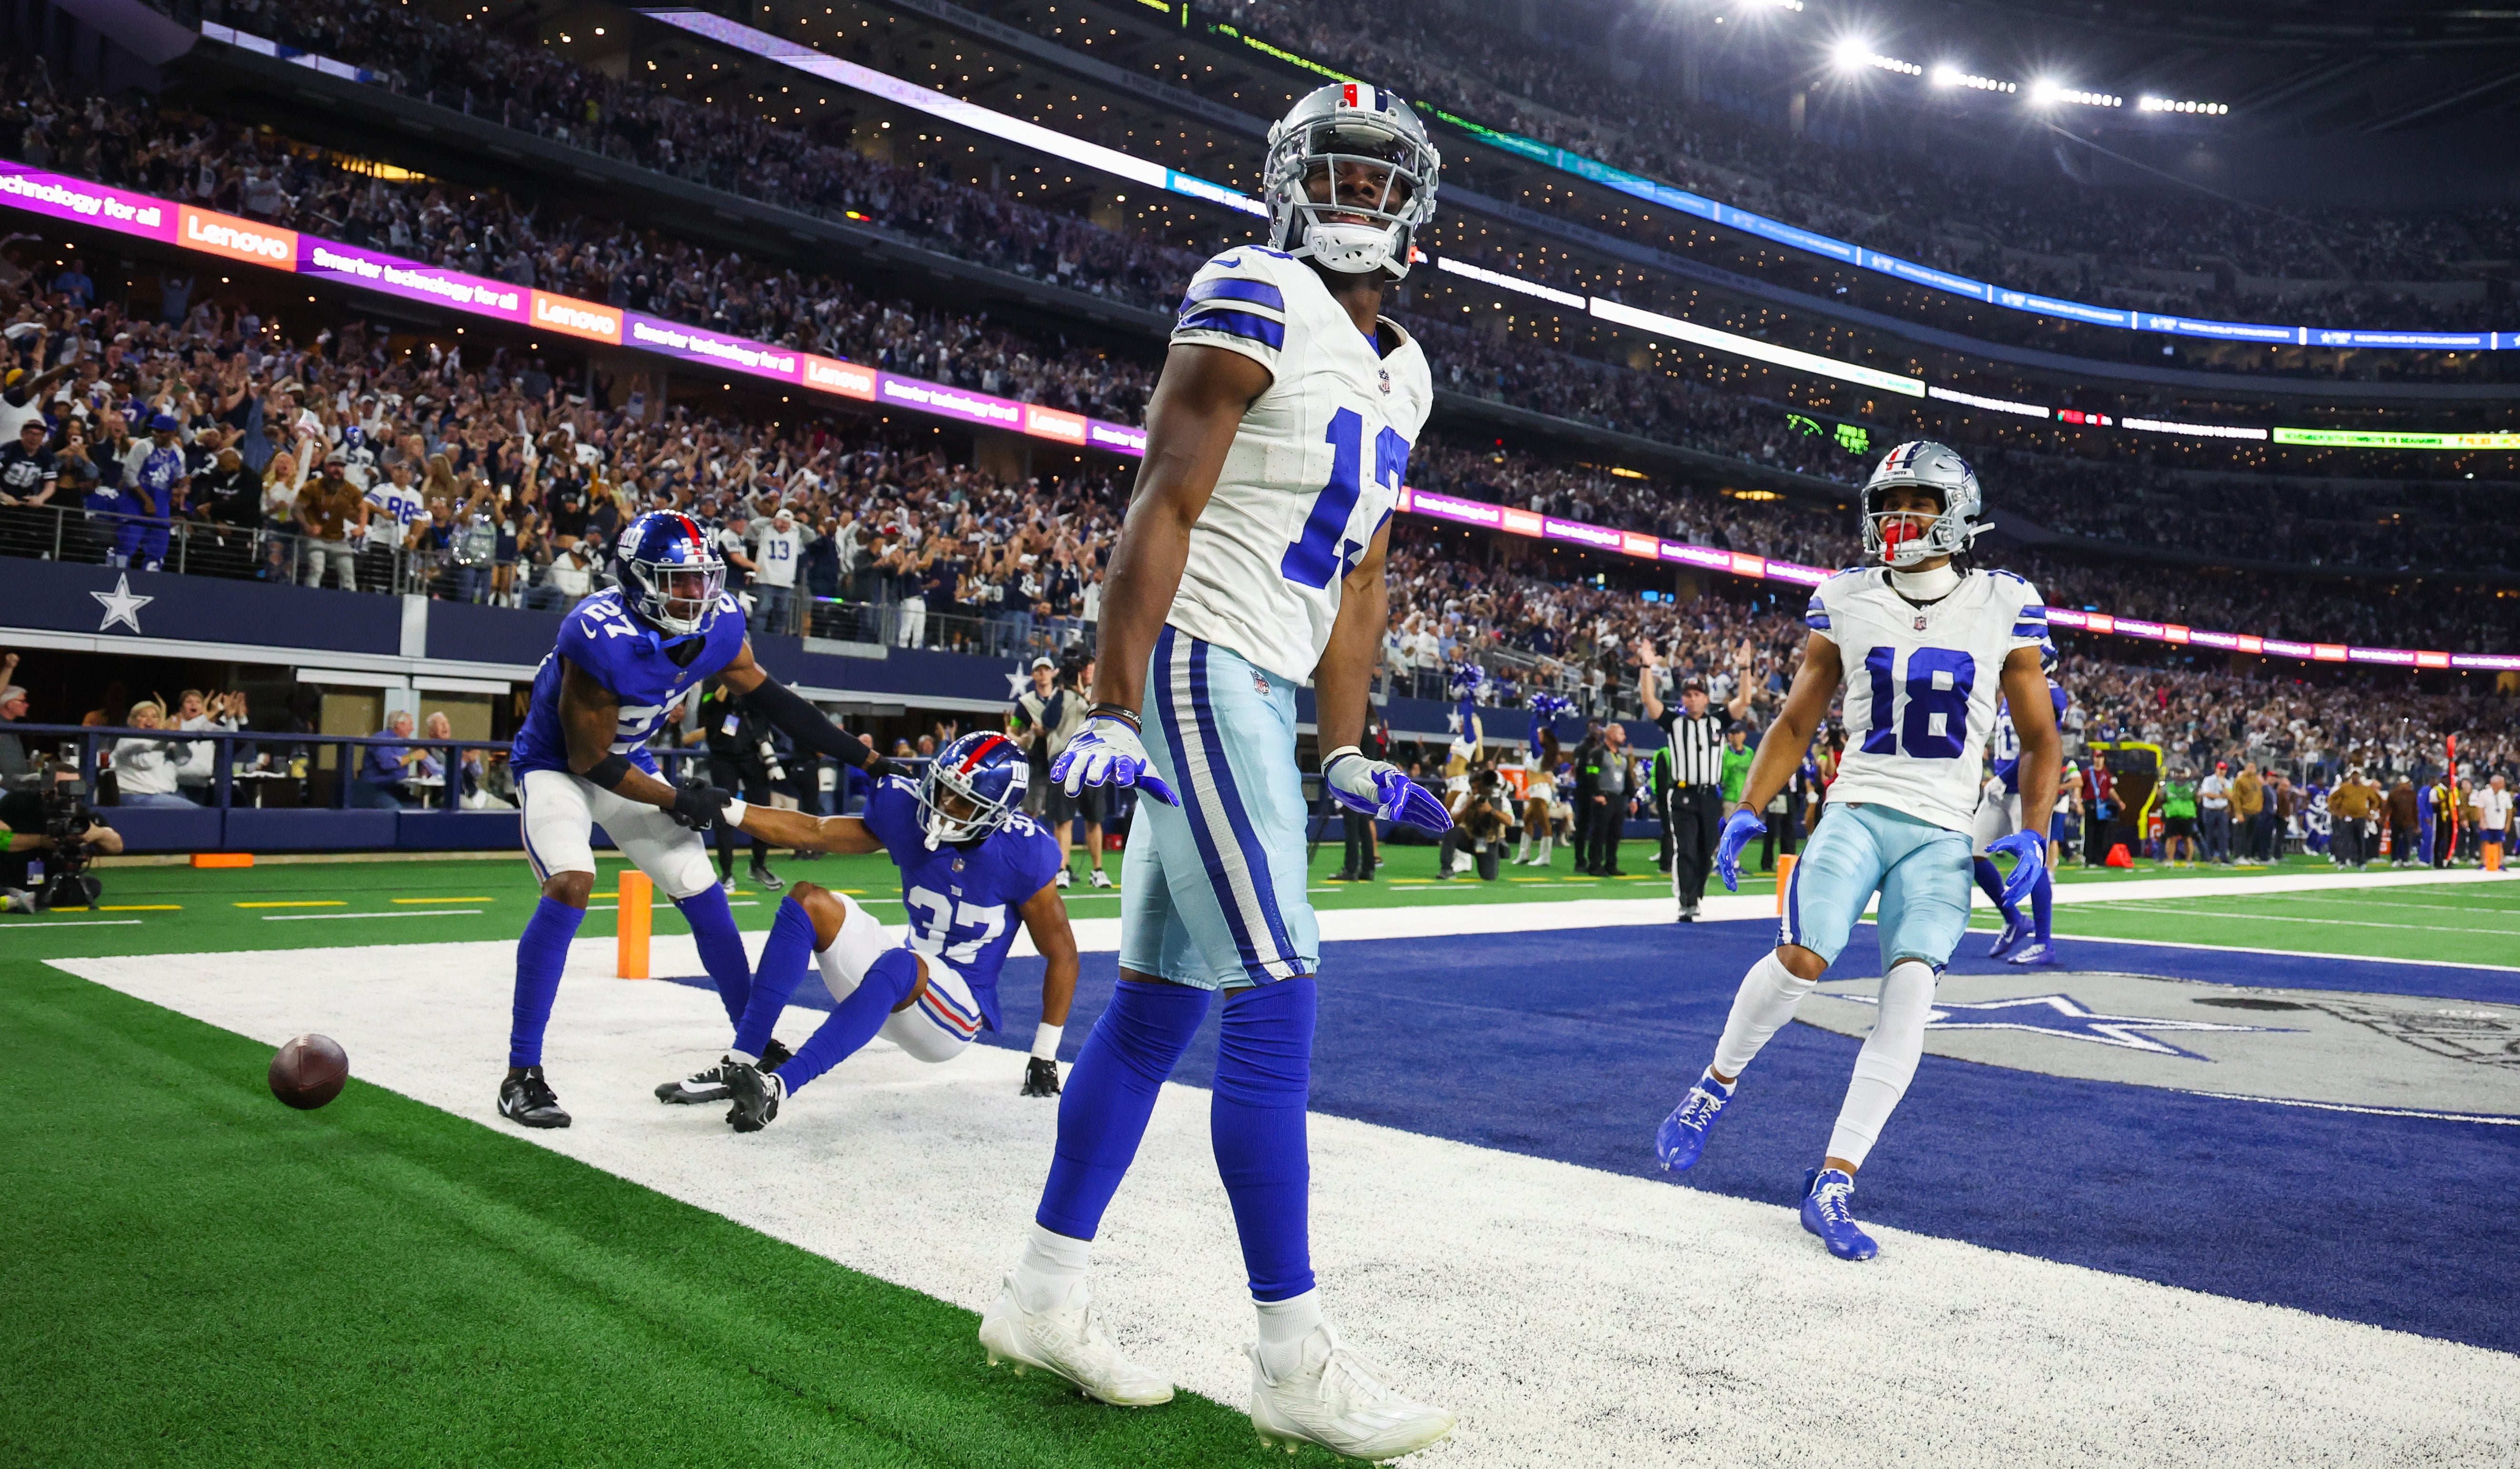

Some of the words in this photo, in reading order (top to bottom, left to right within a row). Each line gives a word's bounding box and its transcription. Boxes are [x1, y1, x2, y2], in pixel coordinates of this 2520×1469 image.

[0, 175, 102, 215] chnology
[104, 197, 136, 220] for
[136, 207, 160, 227] all
[188, 215, 289, 259] Lenovo
[313, 248, 382, 279] Smarter
[383, 265, 474, 303] technology
[474, 285, 499, 306] for
[498, 292, 518, 311] all
[537, 298, 616, 334] Lenovo
[633, 322, 689, 348] Smarter
[808, 361, 872, 392] Lenovo
[1029, 410, 1084, 438] Lenovo
[389, 496, 415, 525] 88
[680, 537, 709, 555] 27
[769, 540, 790, 560] 13
[582, 599, 640, 639] 27
[1860, 646, 1976, 759] 18
[953, 754, 990, 779] 37
[907, 885, 1006, 965] 37
